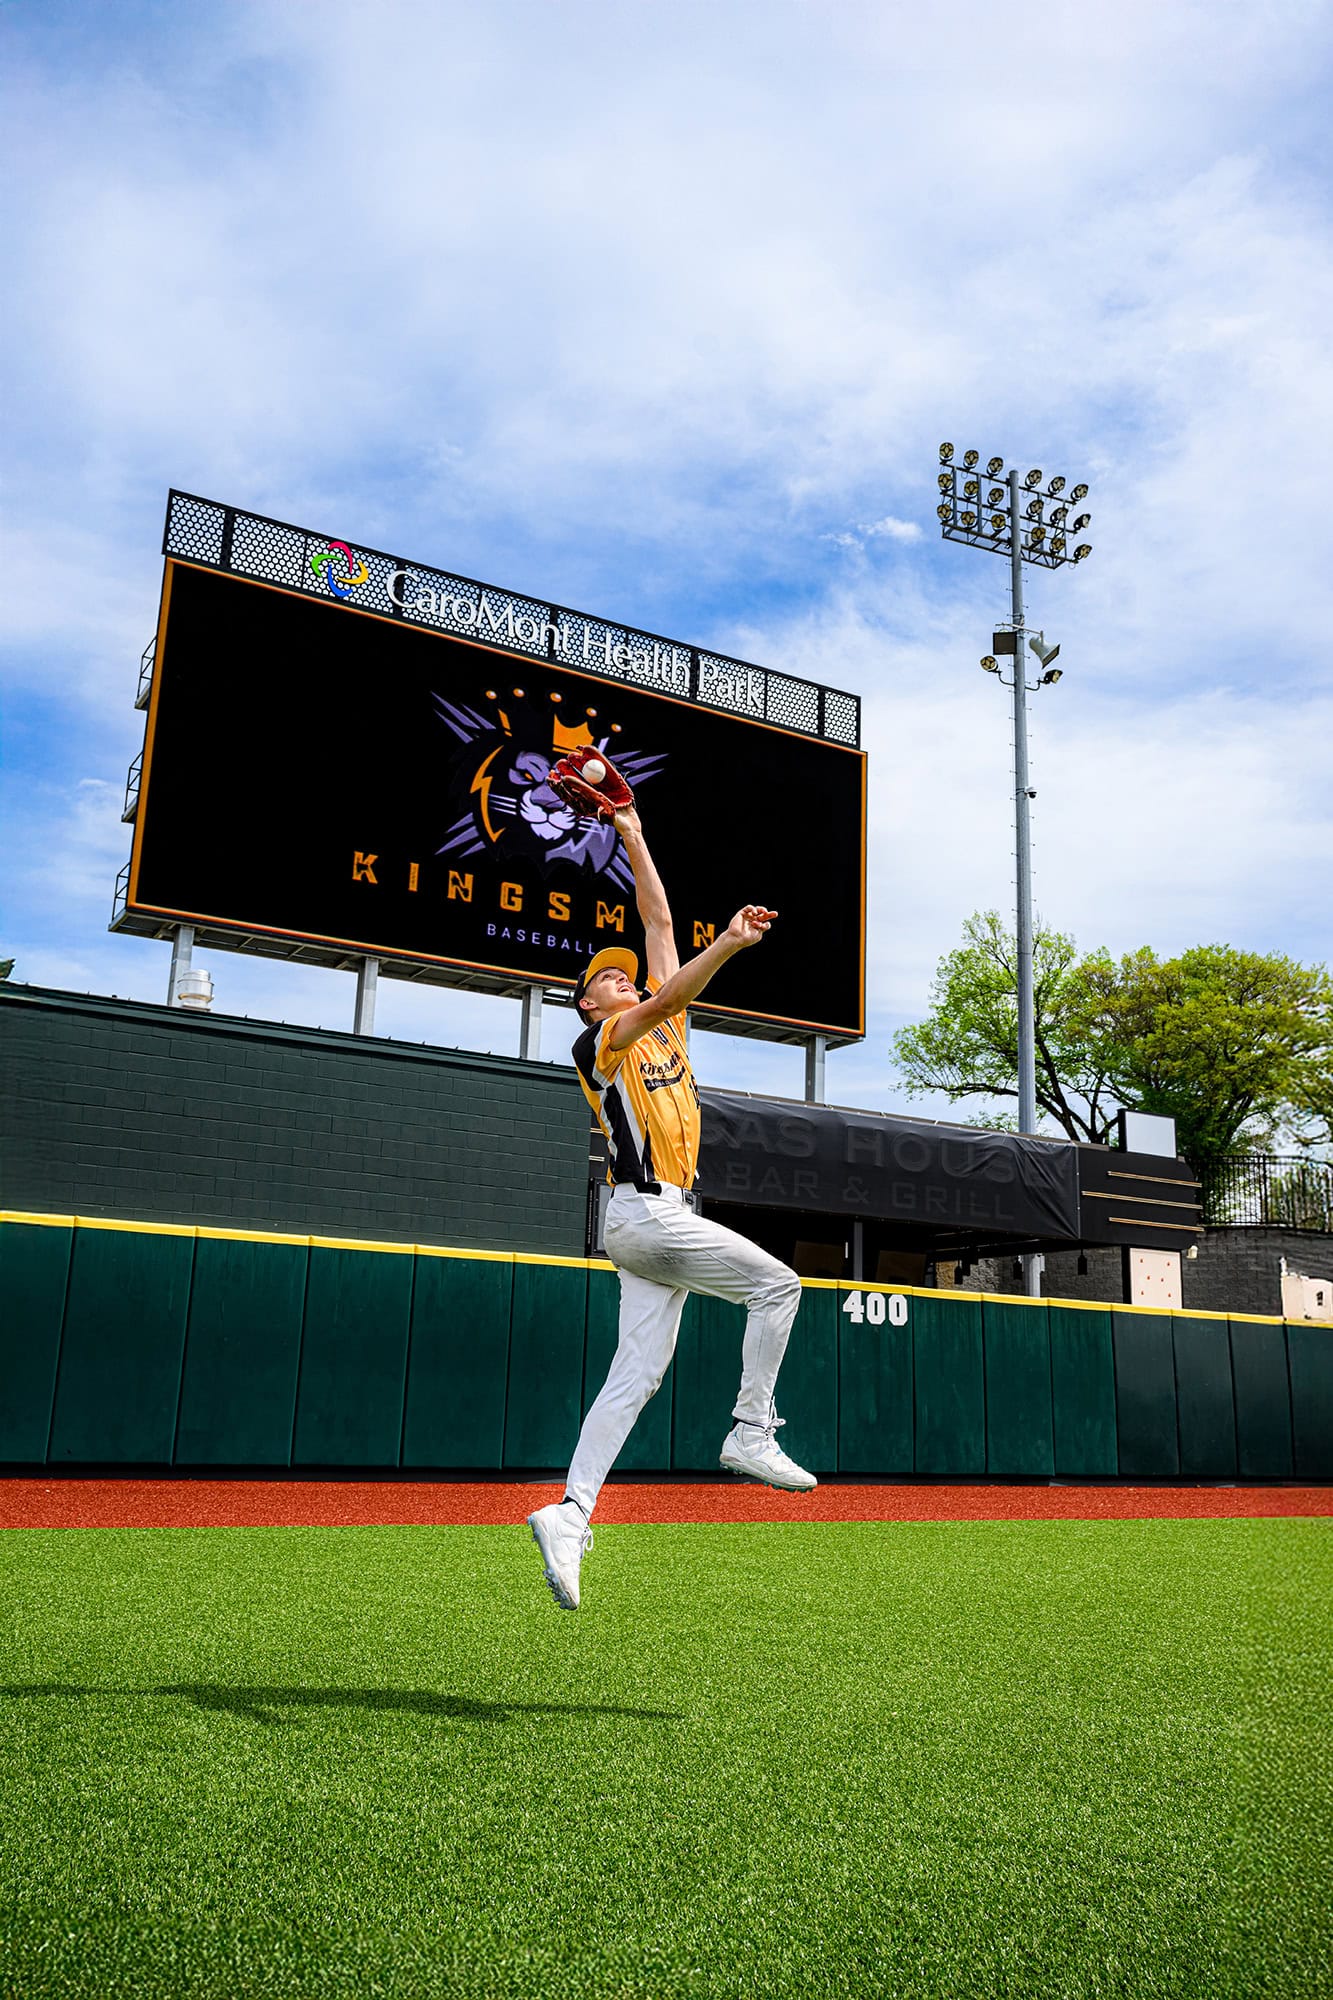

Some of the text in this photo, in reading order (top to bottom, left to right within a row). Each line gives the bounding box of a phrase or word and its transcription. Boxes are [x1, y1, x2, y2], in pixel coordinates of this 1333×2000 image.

[386, 569, 764, 711] CaroMont Health Park
[351, 850, 715, 949] KINGSMN
[487, 923, 596, 956] BASEBALL
[725, 1161, 821, 1198] BAR
[891, 1182, 1016, 1221] GRILL
[843, 1290, 908, 1327] 400
